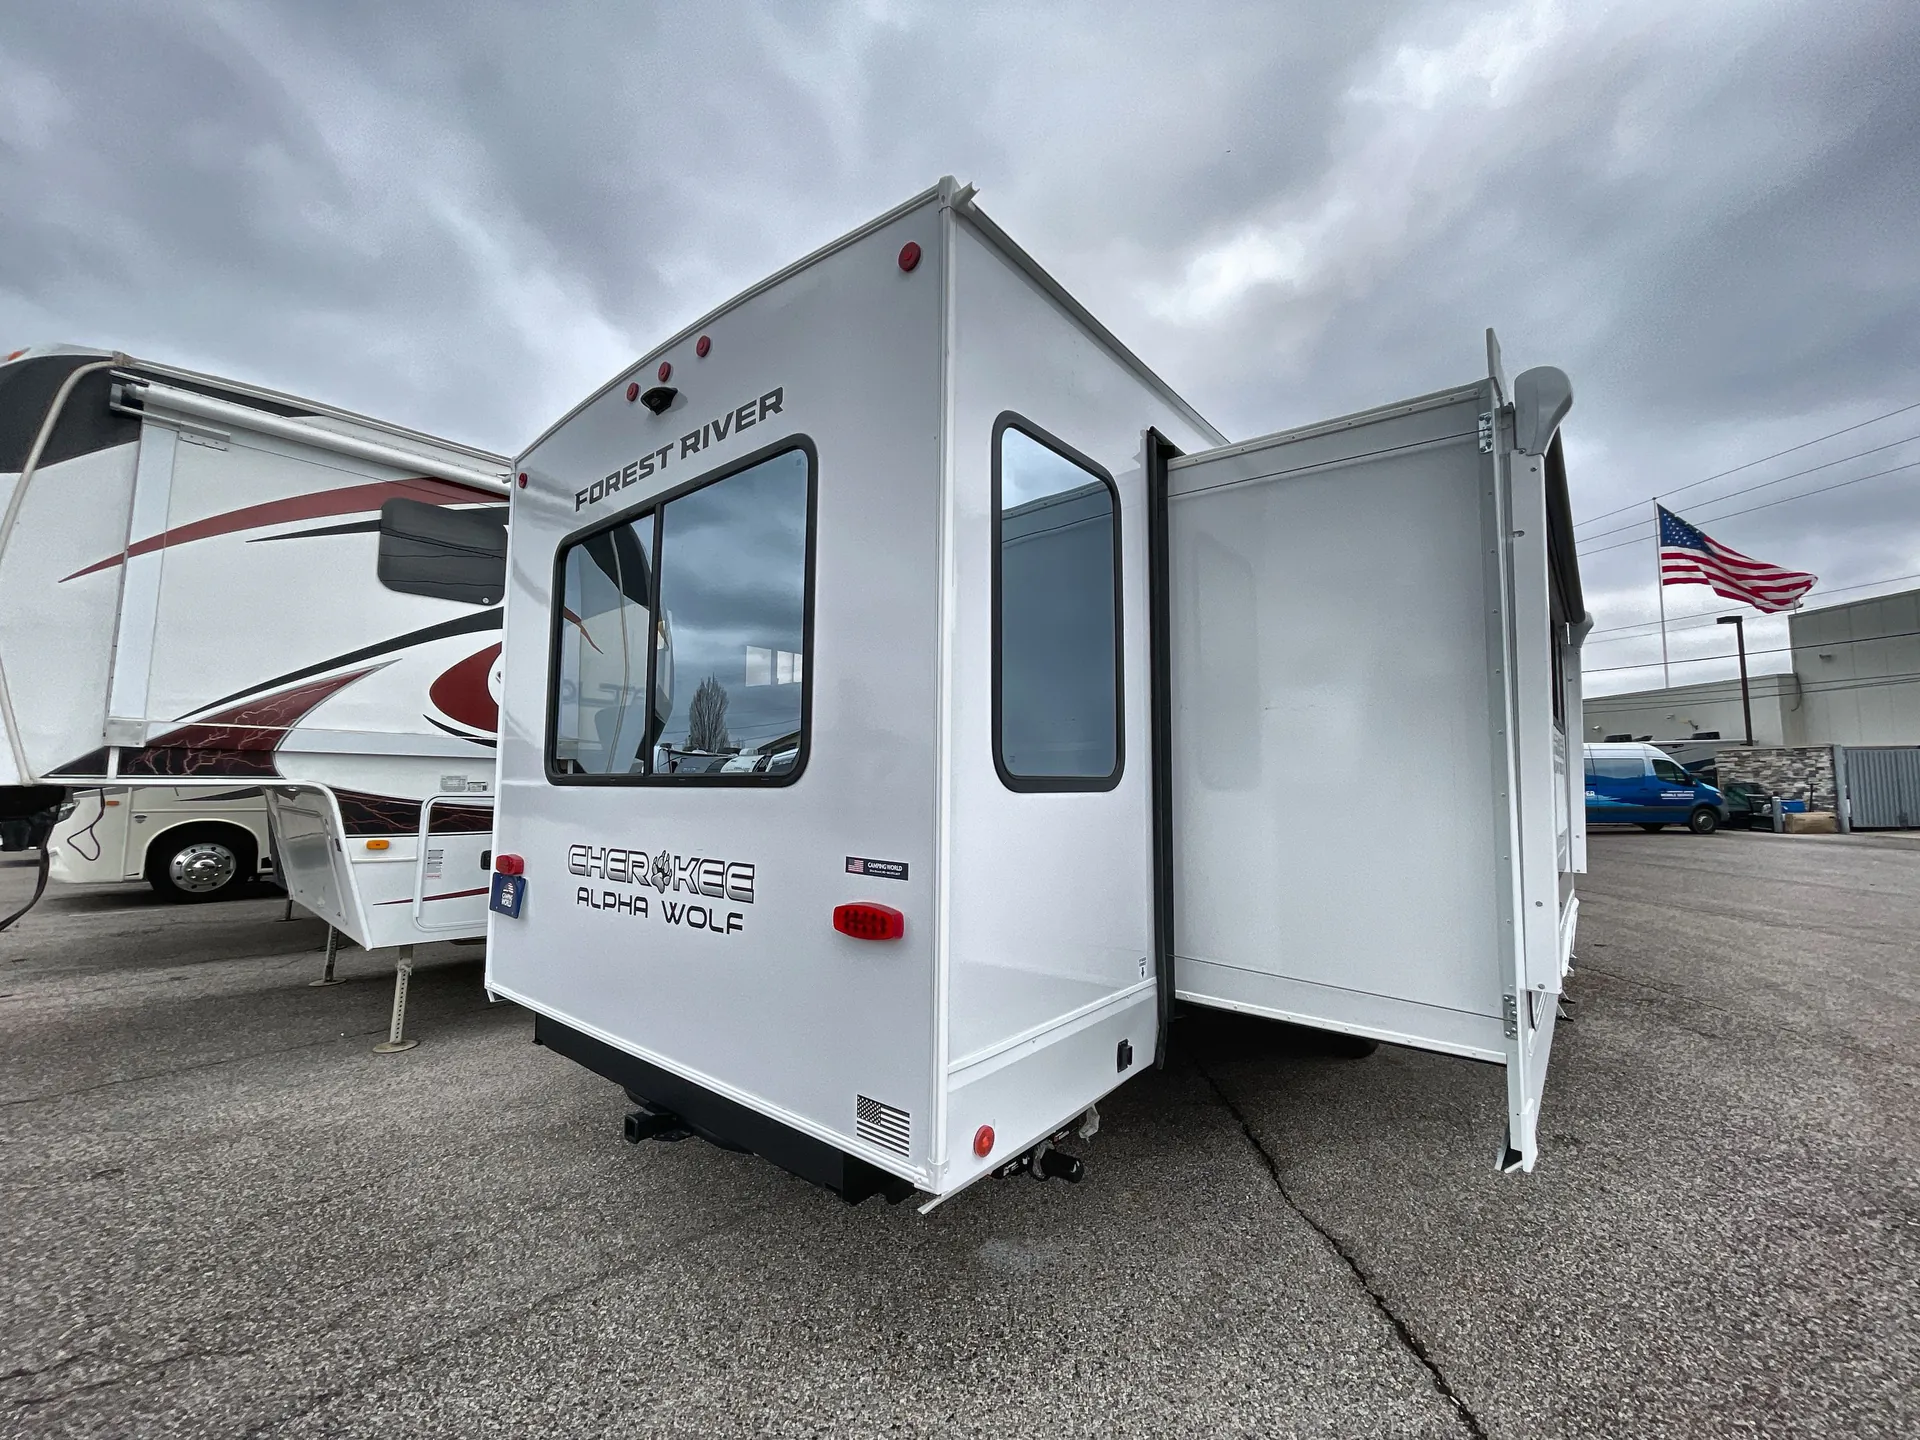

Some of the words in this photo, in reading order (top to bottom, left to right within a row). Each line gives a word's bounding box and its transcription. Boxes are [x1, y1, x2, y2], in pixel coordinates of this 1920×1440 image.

[575, 443, 674, 512] FOREST
[680, 386, 783, 460] RIVER
[867, 862, 887, 870] CAMPING
[887, 864, 903, 872] WORLD
[577, 886, 649, 918] ALPHA
[661, 900, 744, 935] WOLF
